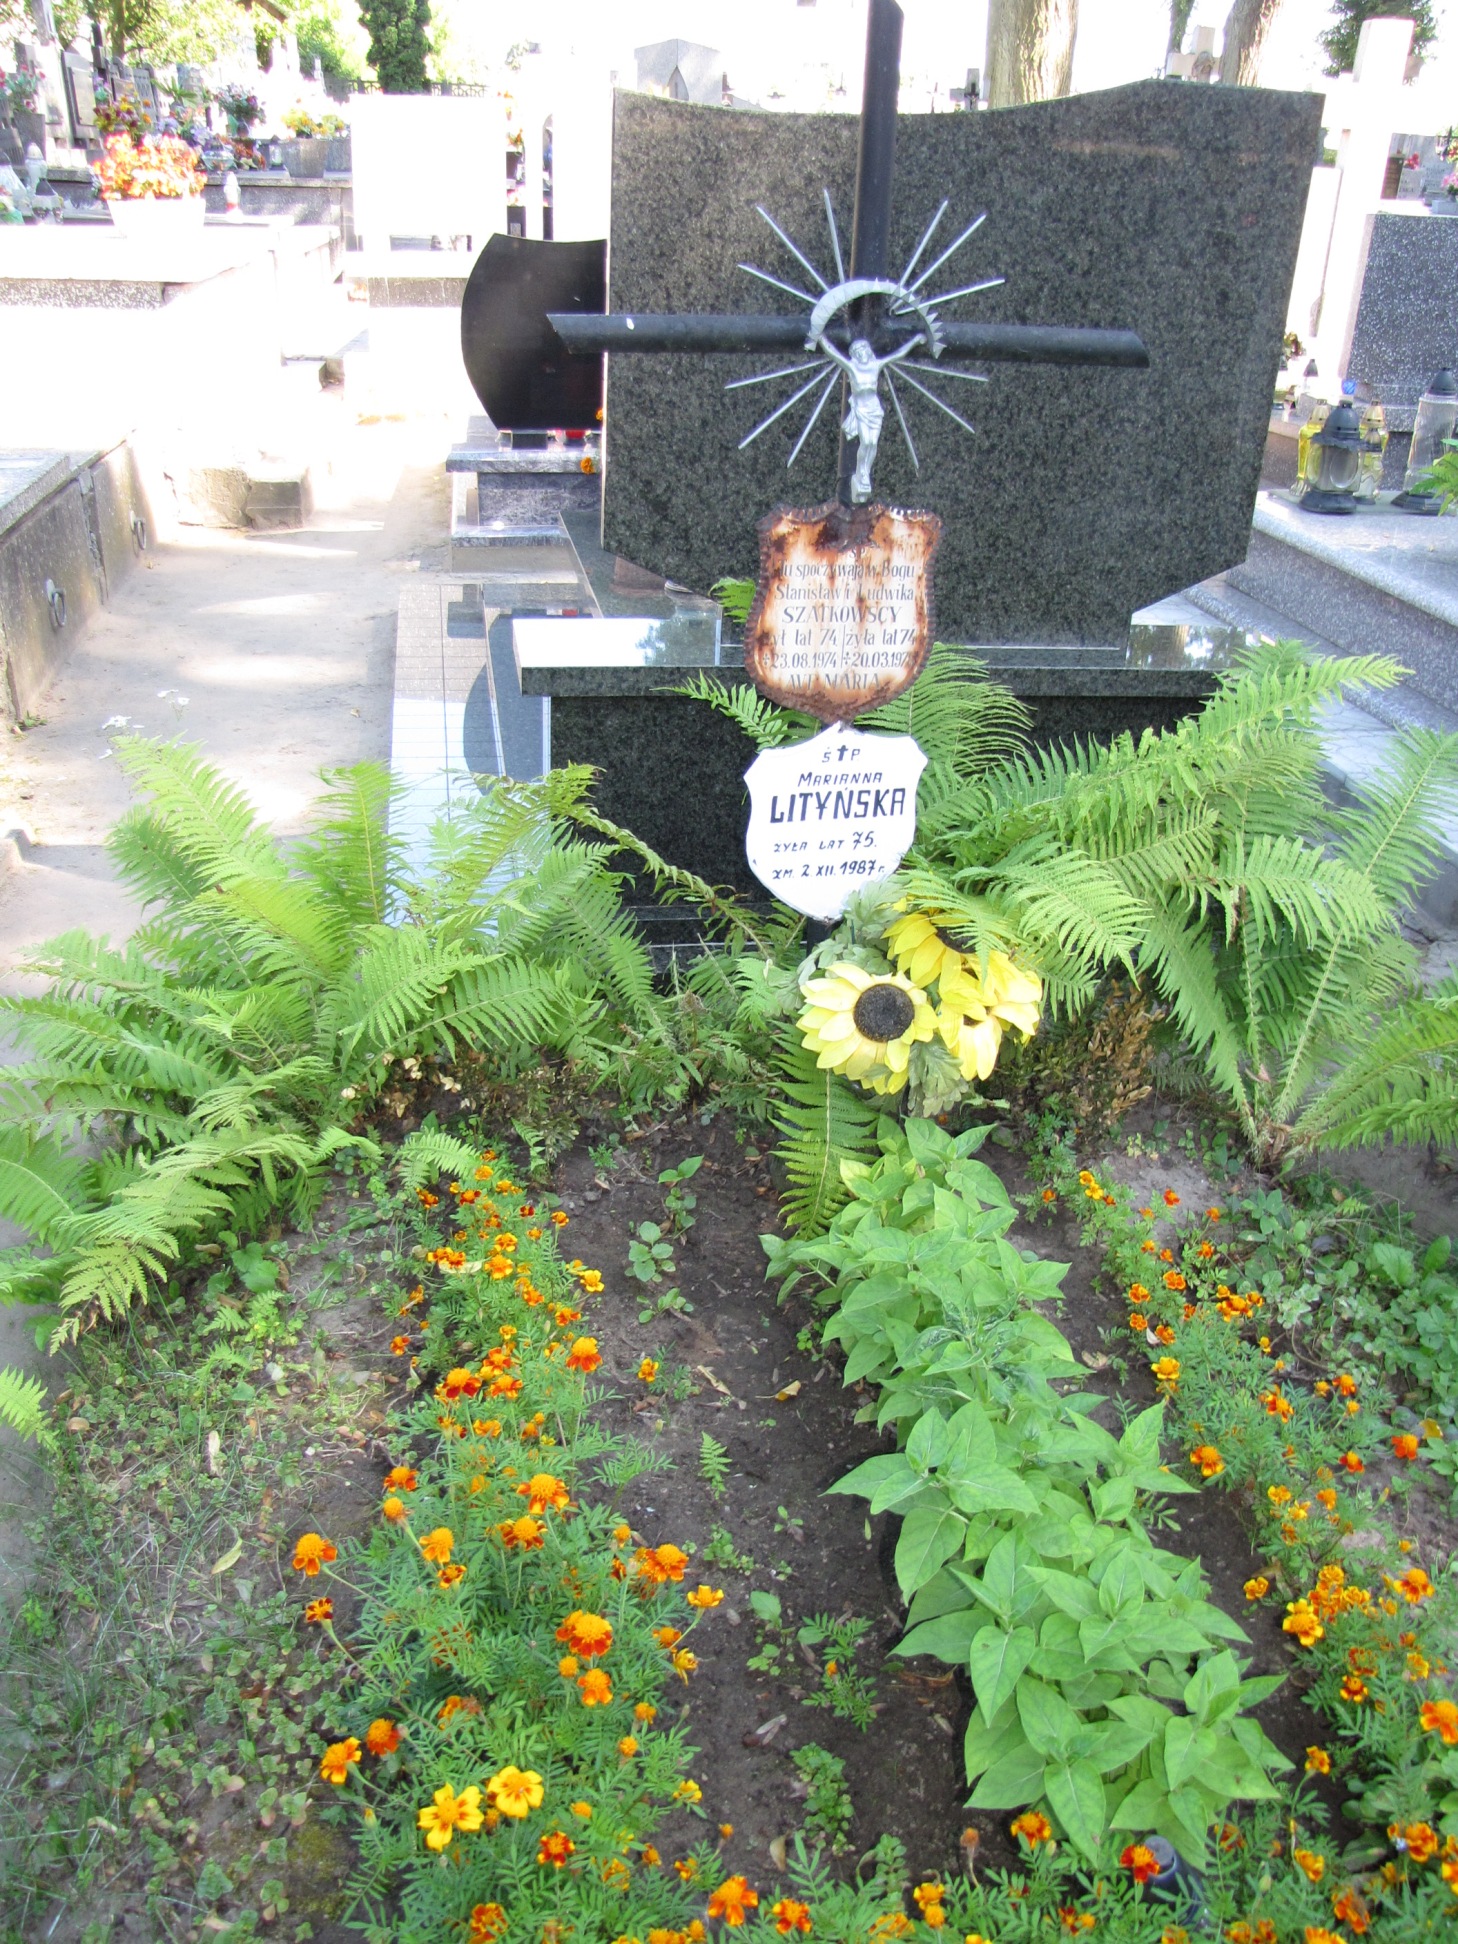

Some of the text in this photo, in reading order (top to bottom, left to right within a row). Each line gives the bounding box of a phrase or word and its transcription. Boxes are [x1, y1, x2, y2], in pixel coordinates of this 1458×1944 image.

[882, 558, 915, 580] Bogu
[775, 583, 841, 600] Stanisław
[781, 606, 903, 624] SZATKOWSCY
[795, 629, 812, 646] lat
[820, 629, 837, 647] 74
[846, 628, 917, 649] żyła lat 74
[770, 652, 837, 669] 23.08.1974
[851, 651, 915, 669] 20.03.197
[823, 672, 880, 691] MARIA
[797, 772, 883, 787] MARIANNA
[769, 786, 906, 824] LITYŃSKA
[818, 839, 845, 850] LAT
